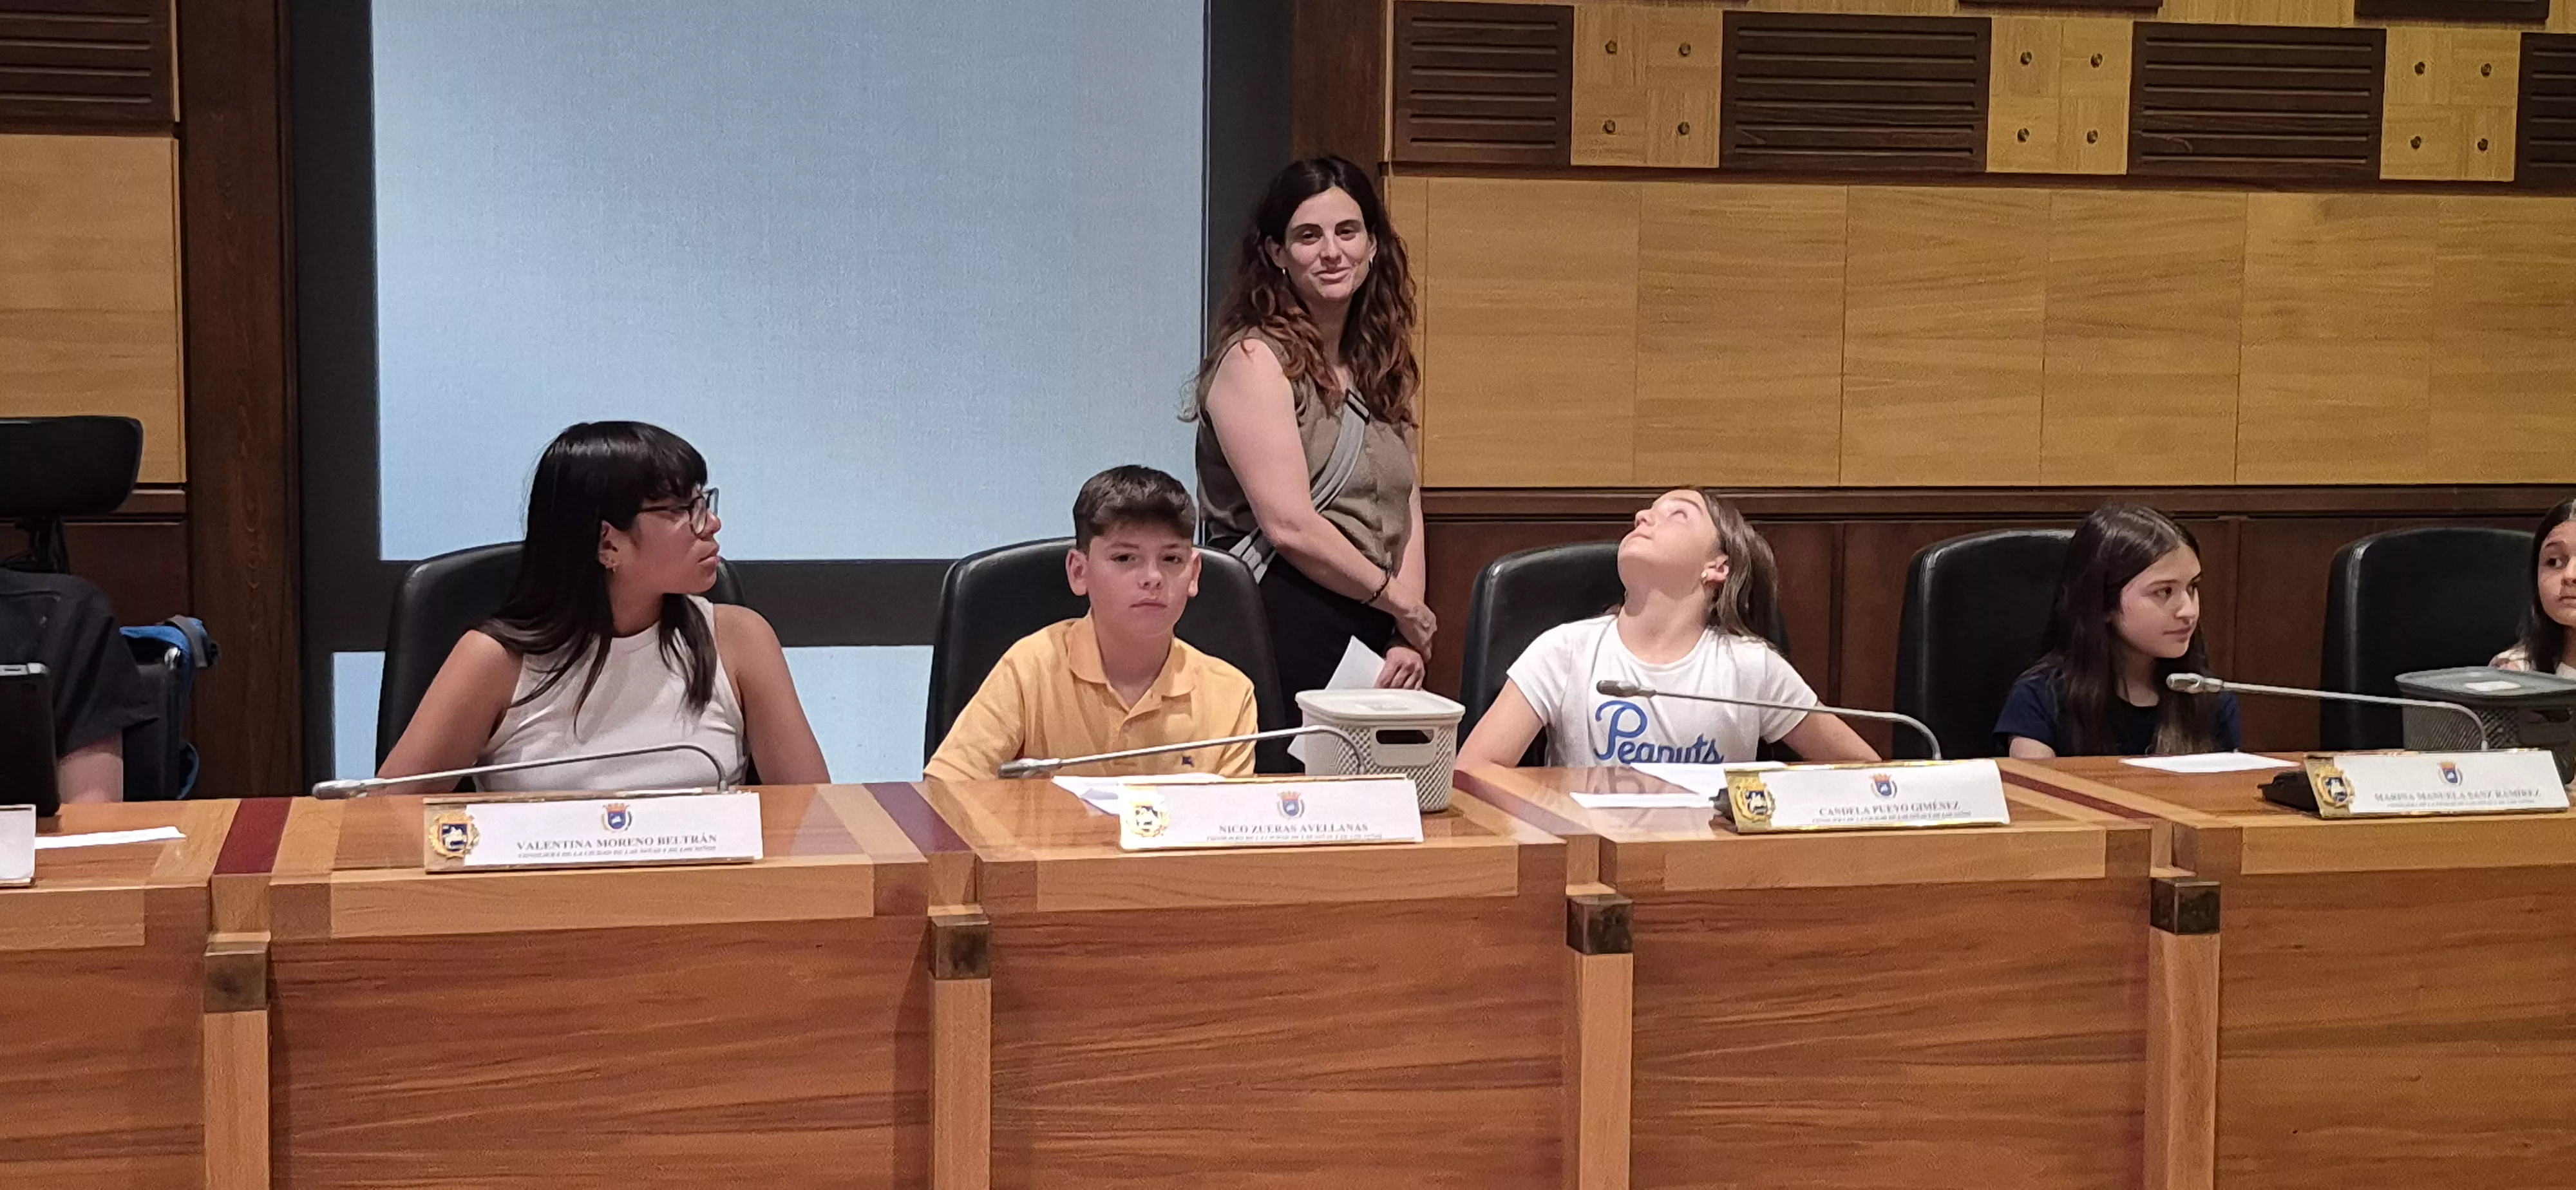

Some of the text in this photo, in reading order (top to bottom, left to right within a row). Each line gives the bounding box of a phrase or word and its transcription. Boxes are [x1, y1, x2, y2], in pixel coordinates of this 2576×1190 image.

[1593, 700, 1724, 764] Peanuts
[1819, 806, 1870, 817] CANDELA
[1219, 822, 1368, 834] NICO ZUERAS AVELLANAS
[516, 832, 718, 851] VALENTINA MORENO BELTRÁN
